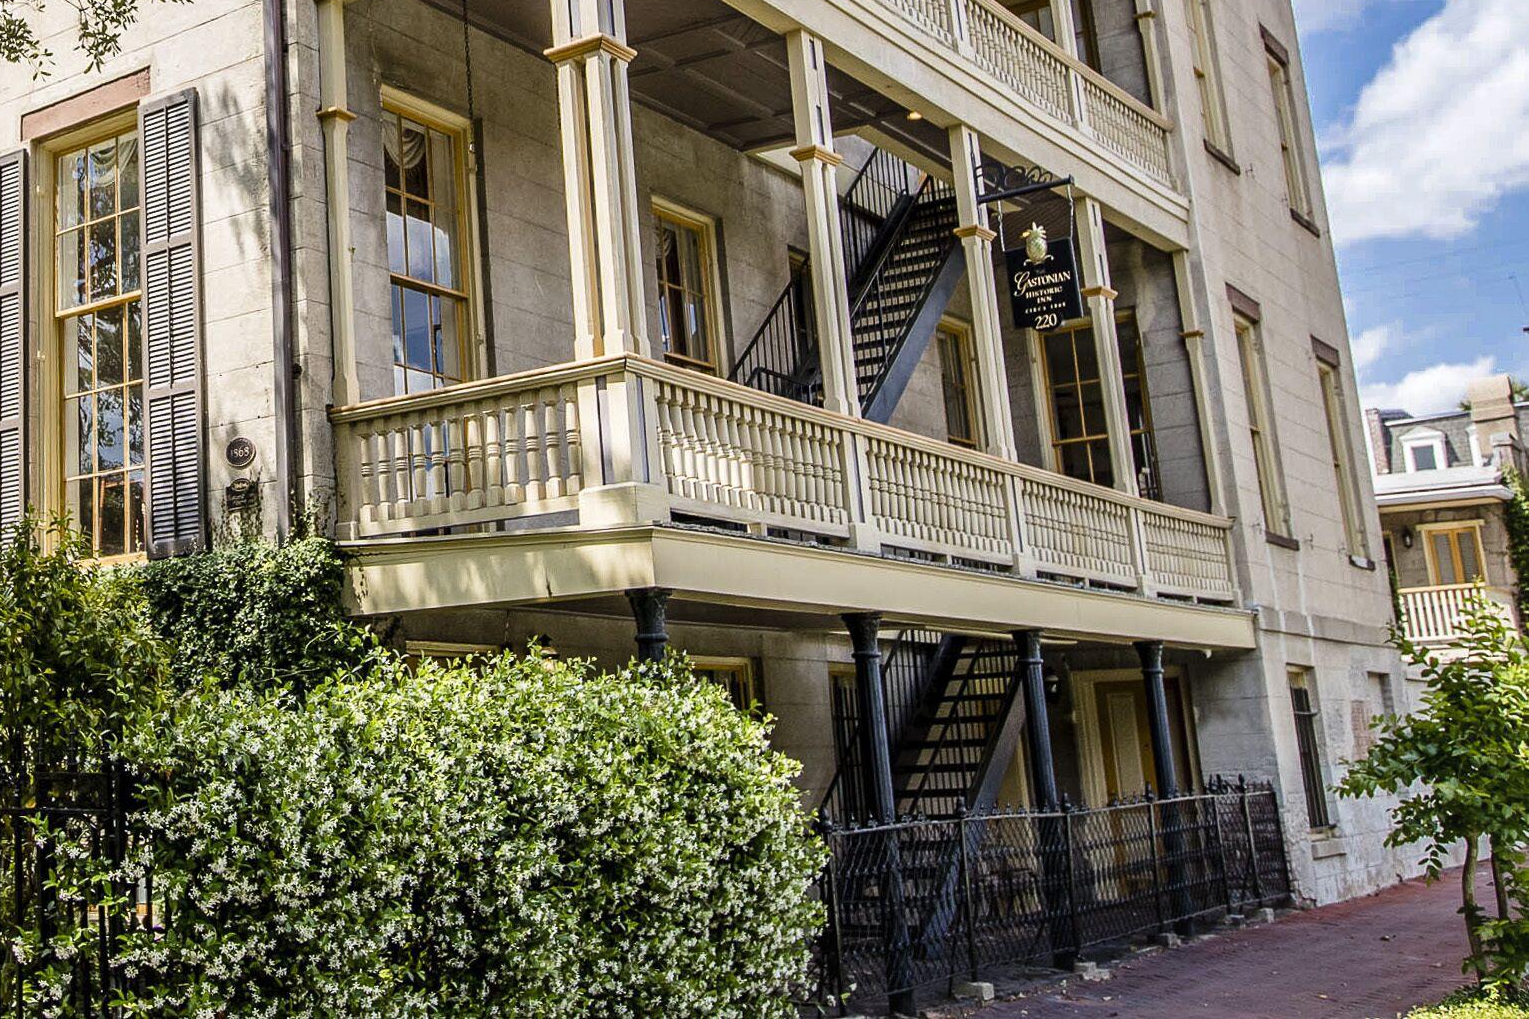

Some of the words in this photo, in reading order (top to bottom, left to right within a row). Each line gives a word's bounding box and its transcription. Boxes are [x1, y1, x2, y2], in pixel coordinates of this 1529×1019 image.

[1026, 286, 1063, 298] HISTORIC
[1037, 295, 1052, 304] INN
[1034, 313, 1058, 330] 220
